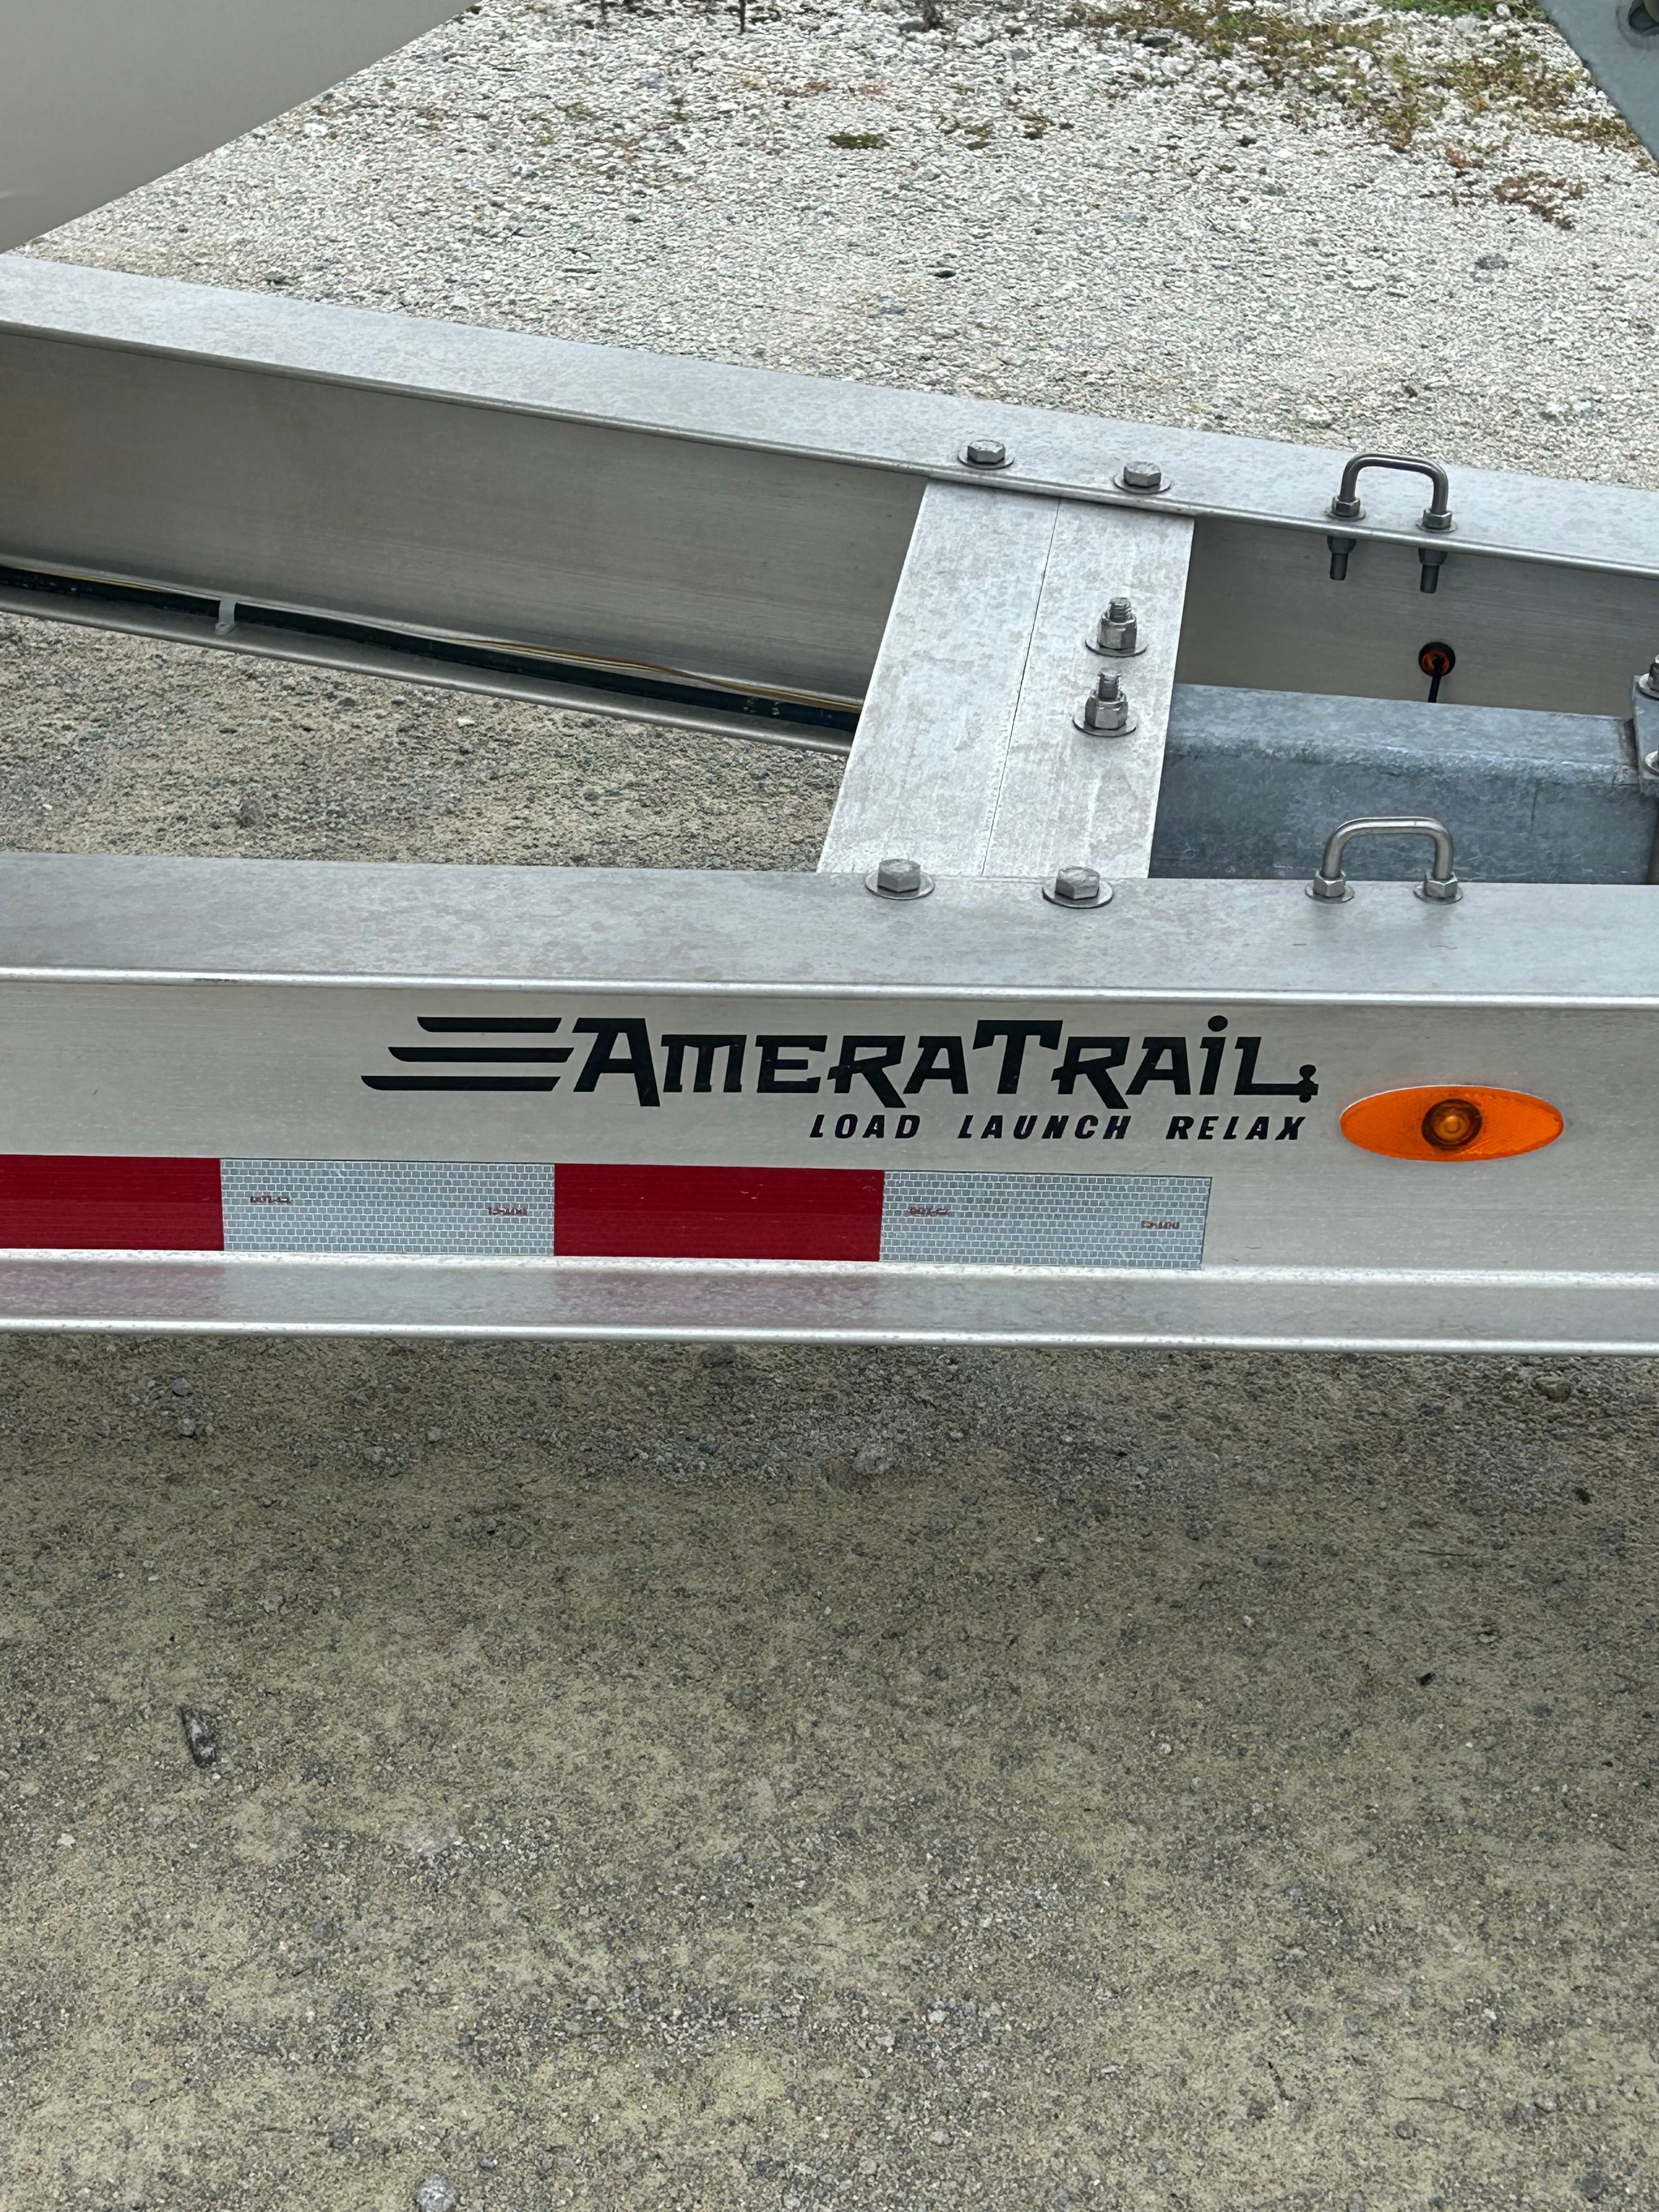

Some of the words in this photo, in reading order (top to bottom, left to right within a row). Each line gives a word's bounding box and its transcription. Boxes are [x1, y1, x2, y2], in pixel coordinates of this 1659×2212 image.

[809, 1114, 921, 1139] LOAD
[957, 1114, 1131, 1140] LAUNCH
[1165, 1116, 1306, 1141] RELAX
